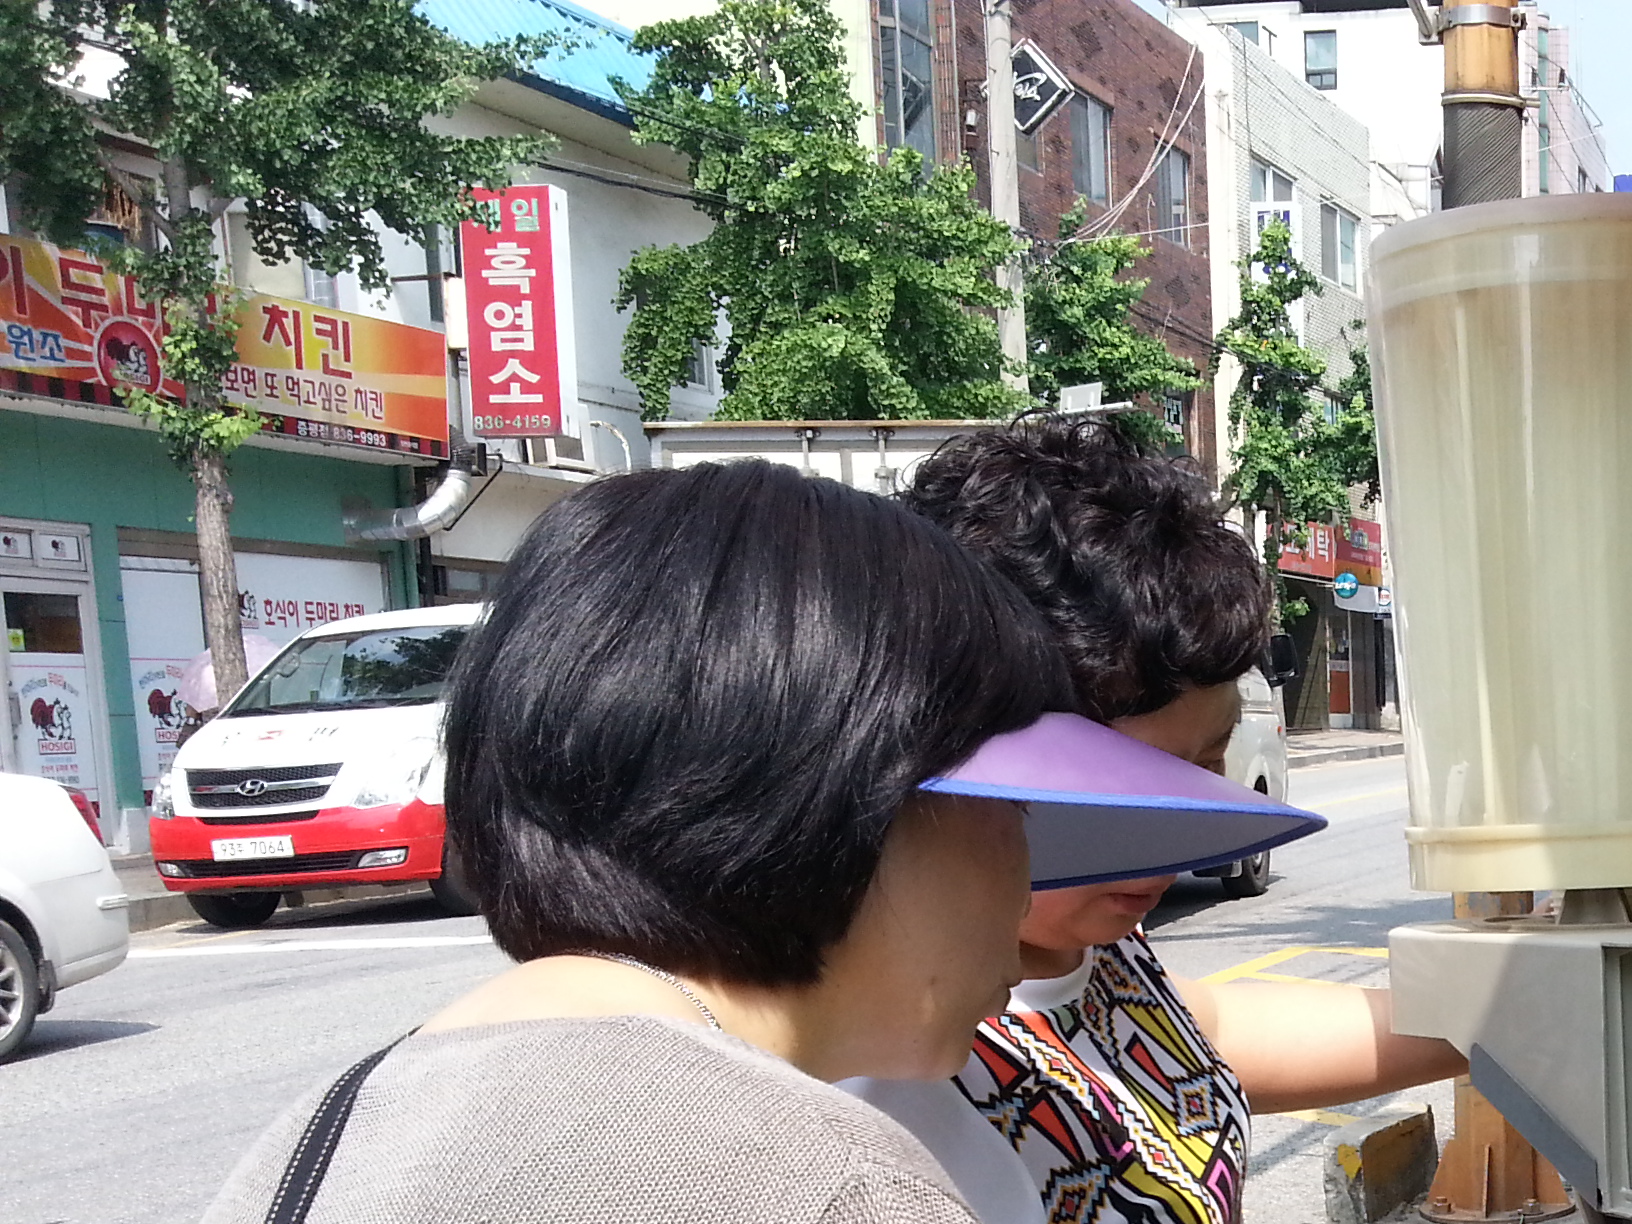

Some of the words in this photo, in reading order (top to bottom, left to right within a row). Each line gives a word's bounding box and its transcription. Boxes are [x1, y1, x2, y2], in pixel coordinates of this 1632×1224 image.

[481, 242, 544, 404] 흑염소
[6, 323, 66, 363] 원조
[261, 303, 354, 380] 치킨
[264, 371, 280, 400] 또
[354, 386, 385, 422] 치킨
[297, 420, 329, 440] 증평점
[333, 426, 387, 447] 836-9993
[474, 414, 551, 431] 836-4159
[263, 598, 301, 629] 호식이
[304, 600, 340, 629] 두마리
[40, 740, 74, 752] HOSIGI
[249, 840, 285, 855] 7064
